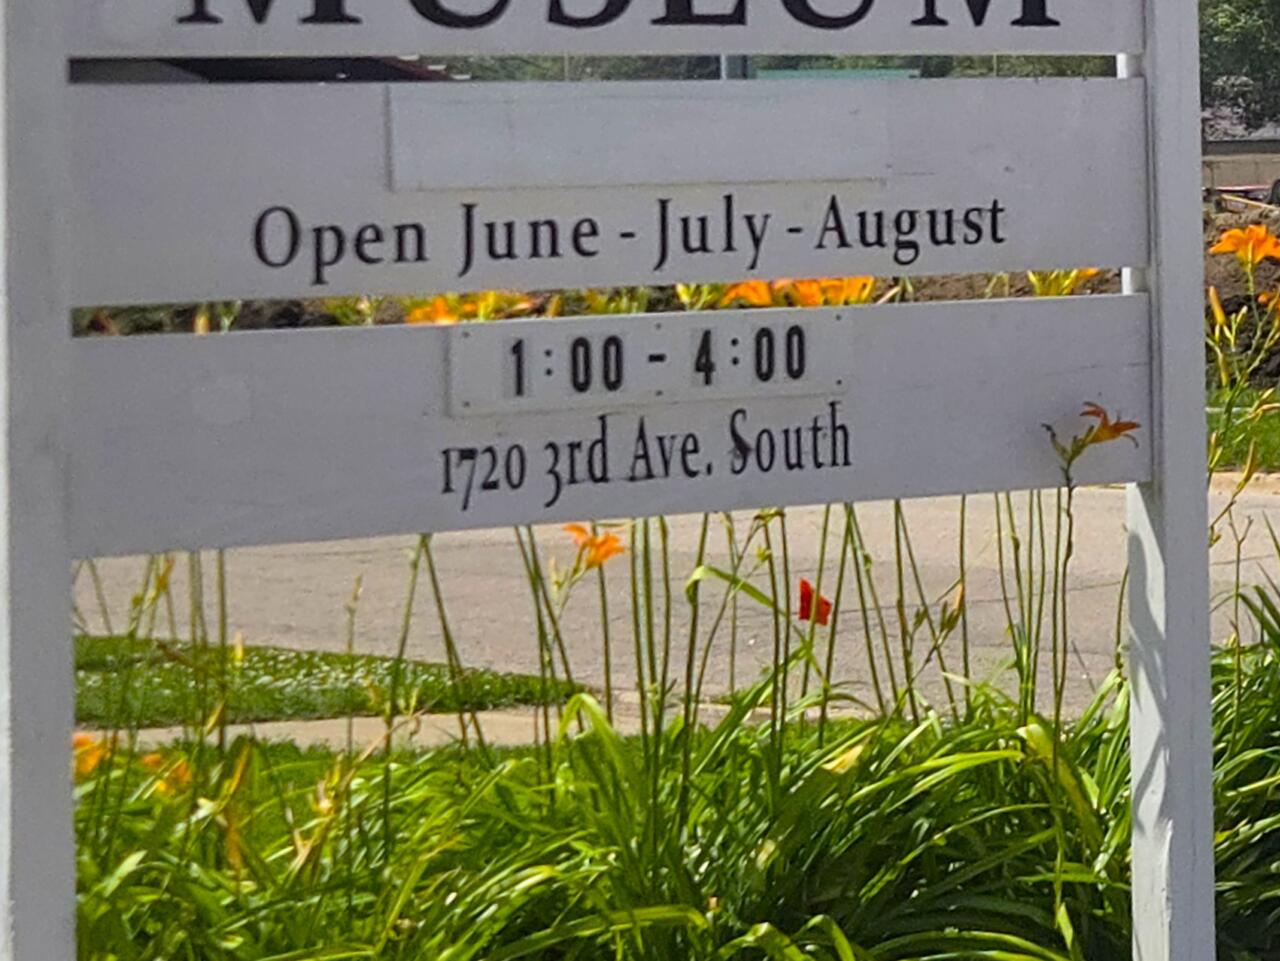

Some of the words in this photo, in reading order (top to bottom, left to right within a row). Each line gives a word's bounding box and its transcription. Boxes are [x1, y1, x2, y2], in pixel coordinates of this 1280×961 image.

[252, 205, 429, 286] Open
[457, 203, 600, 279] June
[652, 193, 772, 273] July
[814, 193, 1007, 266] August
[510, 334, 625, 397] 1:00
[692, 323, 808, 388] 4:00
[440, 443, 528, 512] 1720
[542, 415, 611, 509] 3rd
[623, 416, 715, 483] Ave.
[729, 399, 853, 476] South
